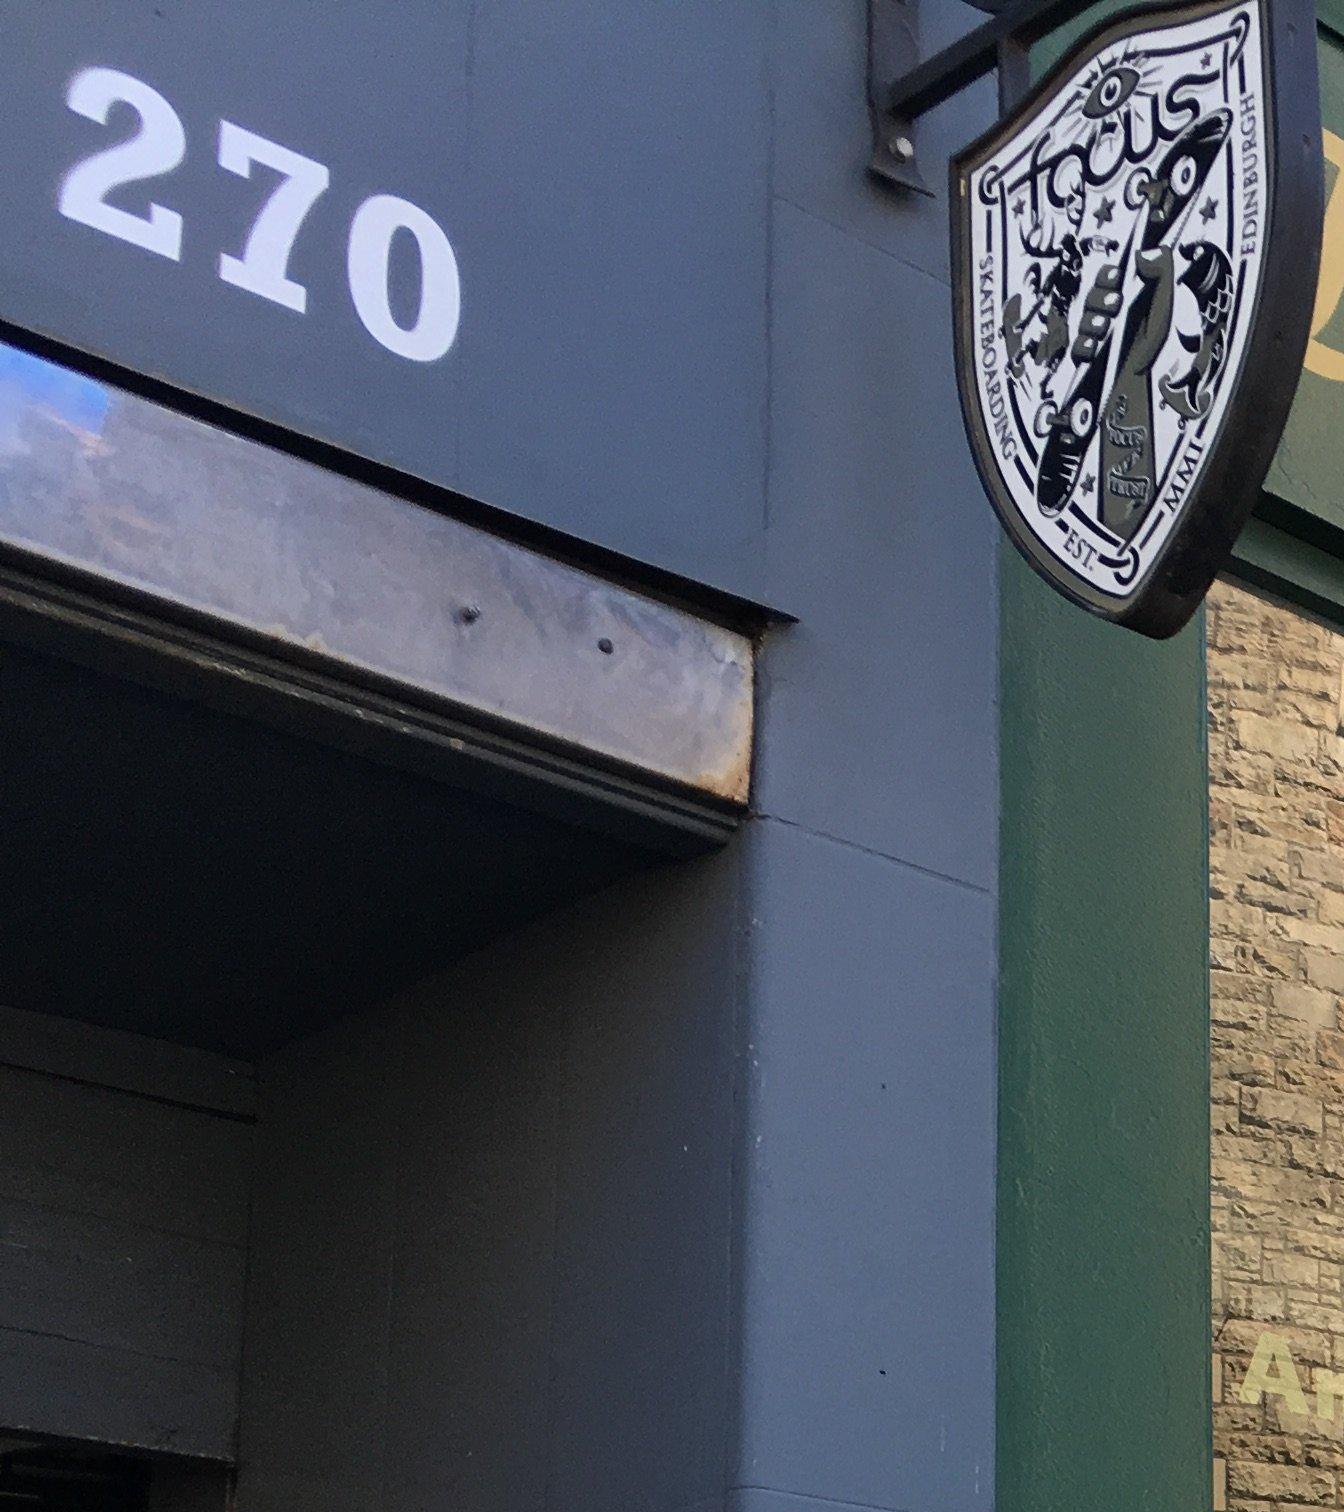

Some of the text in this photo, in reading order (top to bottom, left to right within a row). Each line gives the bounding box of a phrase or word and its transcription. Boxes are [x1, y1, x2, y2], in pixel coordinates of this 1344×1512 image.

[56, 66, 462, 364] 270
[1240, 92, 1257, 259] EDINBURGH
[978, 253, 1018, 462] SKATEBOARDING
[1062, 530, 1097, 572] EST.
[1163, 440, 1204, 514] MMI
